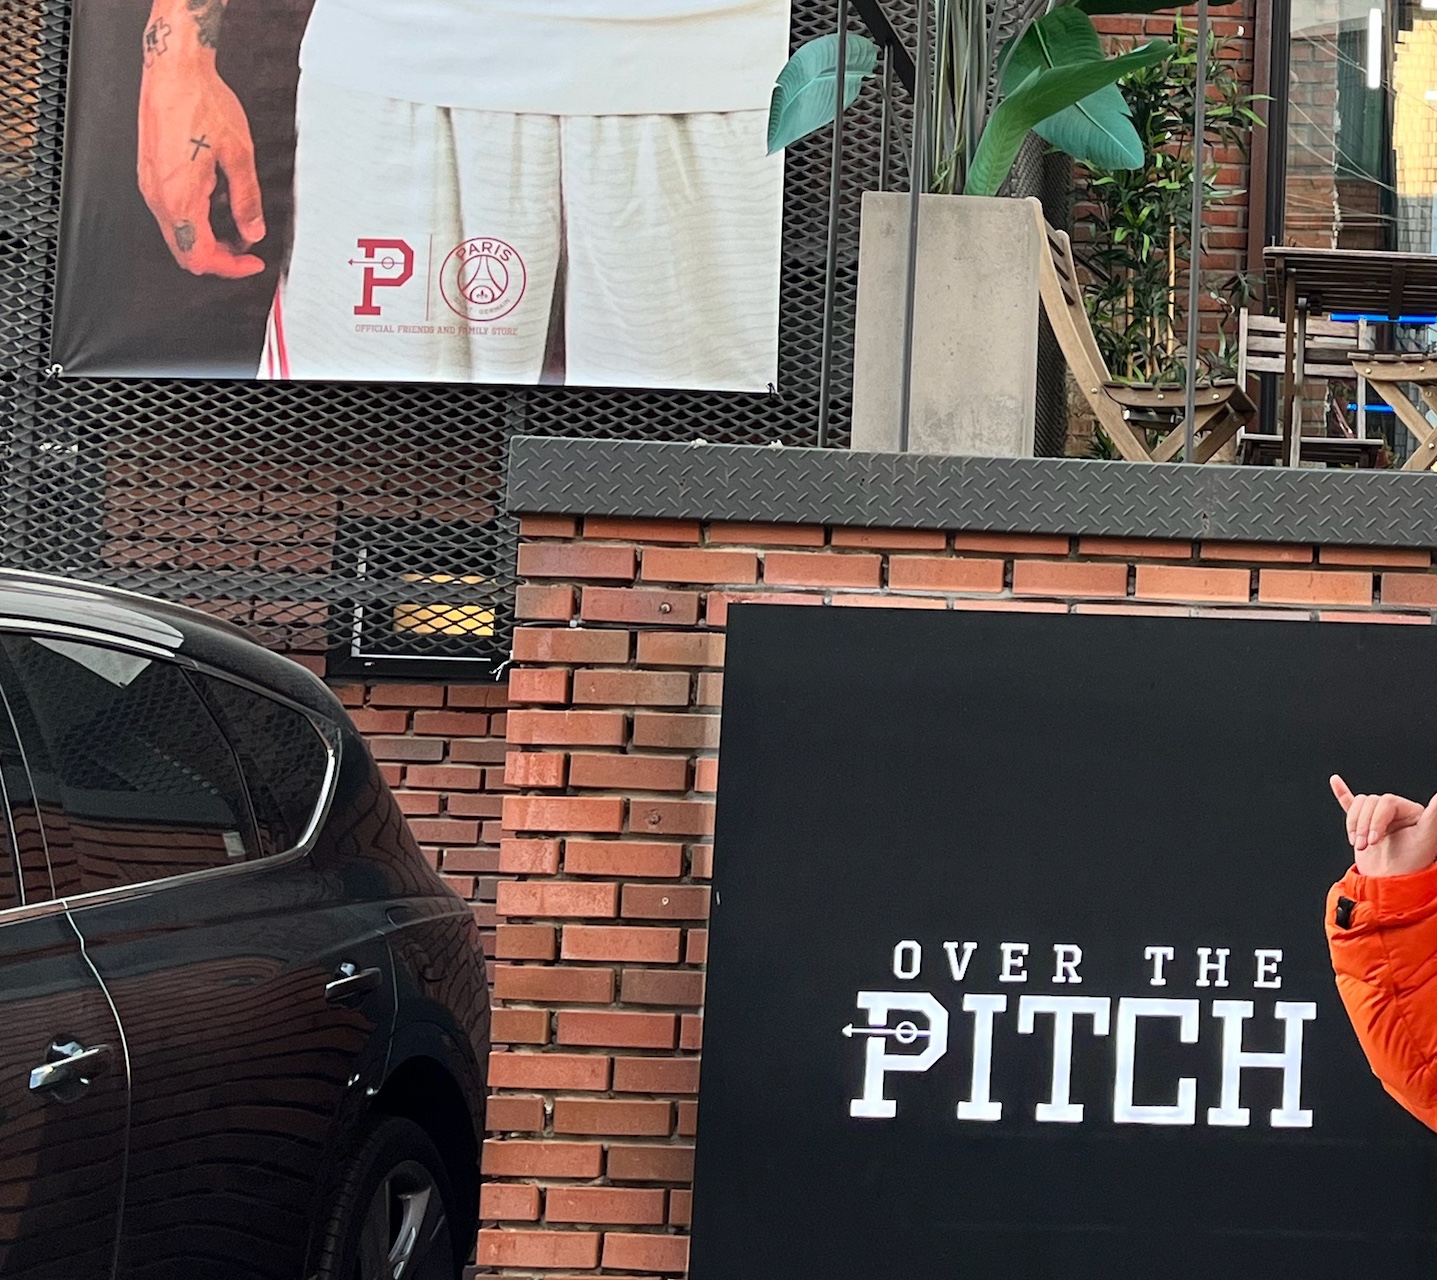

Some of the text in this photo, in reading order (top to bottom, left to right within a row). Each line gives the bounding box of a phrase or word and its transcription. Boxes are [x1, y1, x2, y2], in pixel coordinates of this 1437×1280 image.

[455, 241, 513, 262] PARIS
[355, 323, 519, 337] OFFICIAL FRIENDS AND FAMILY STORE
[893, 939, 1285, 990] OVER THE
[848, 990, 1318, 1129] PITCH
